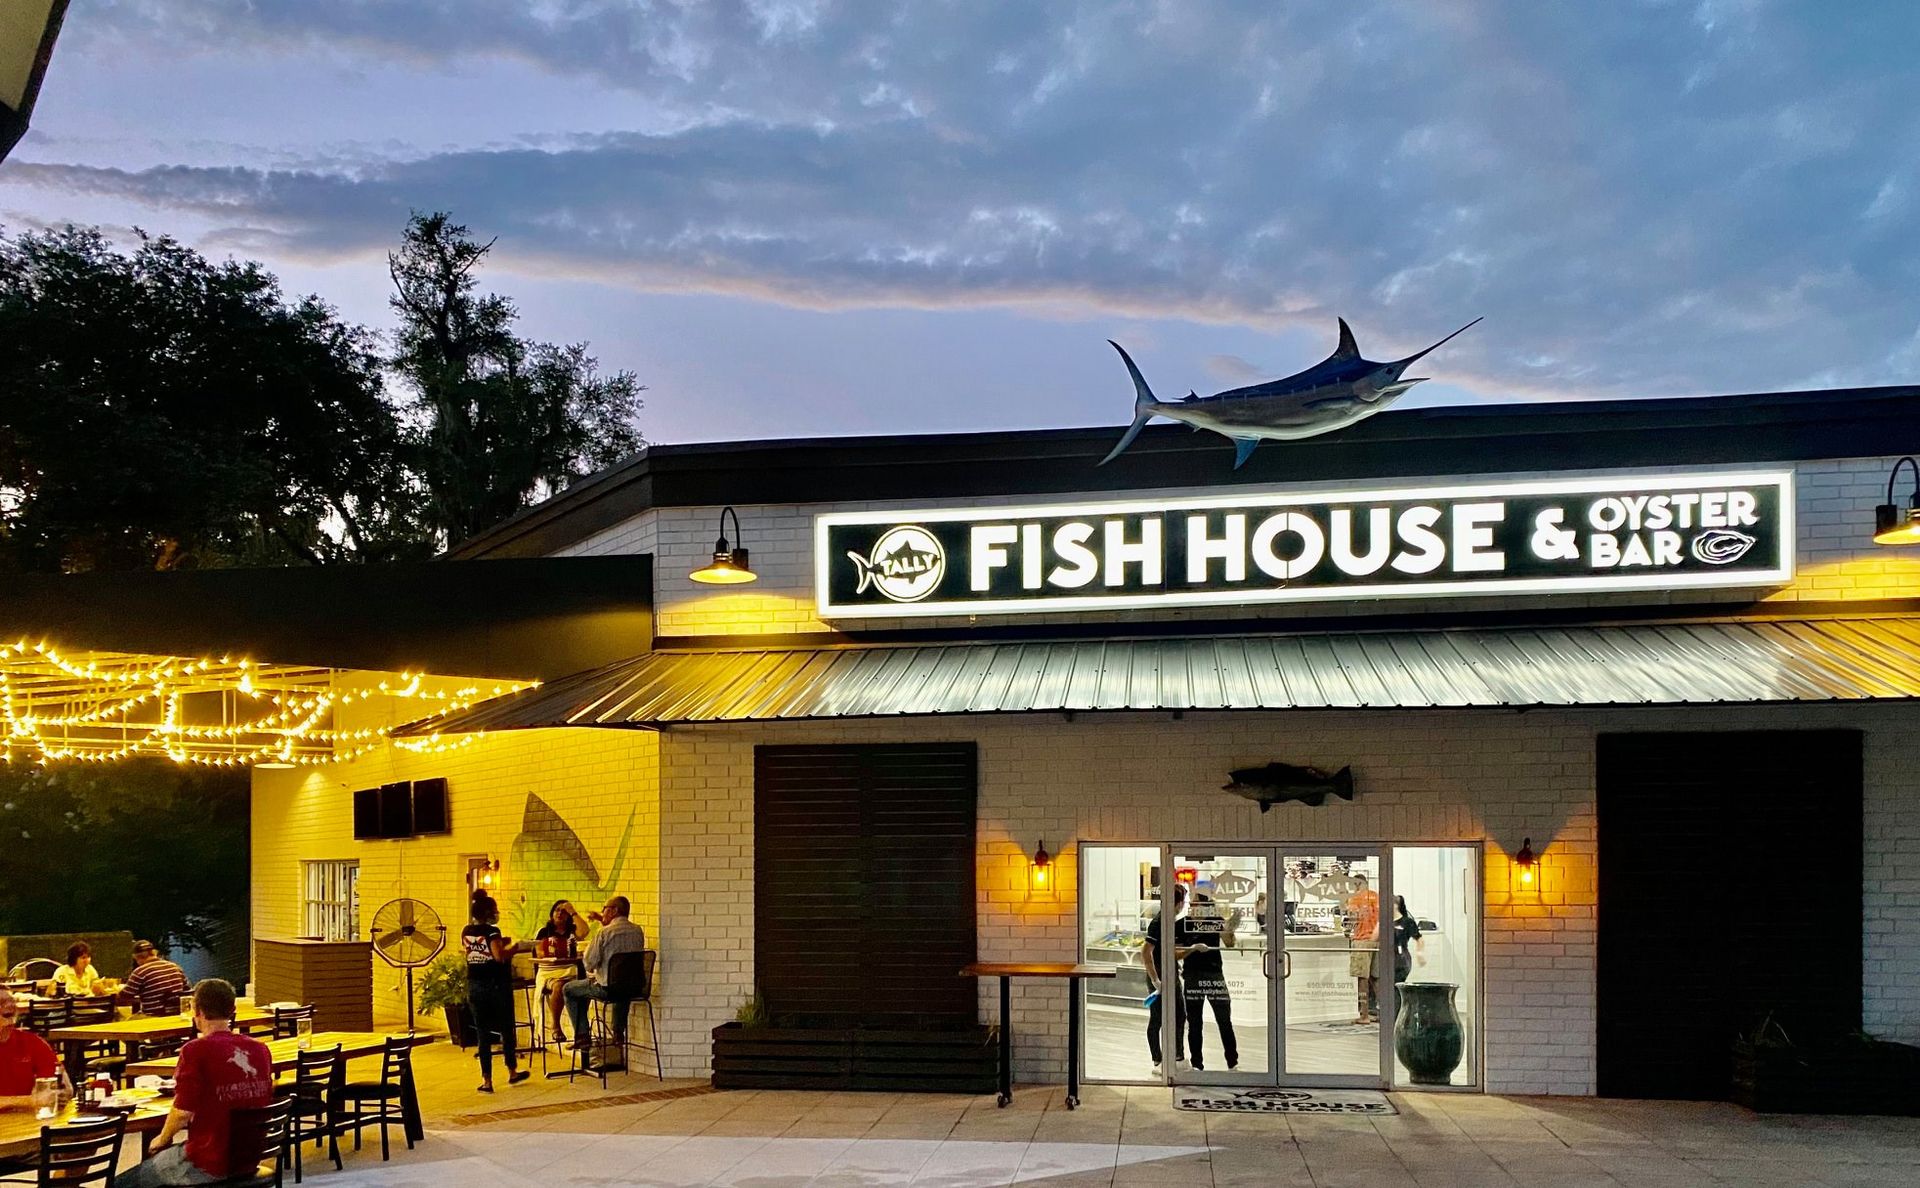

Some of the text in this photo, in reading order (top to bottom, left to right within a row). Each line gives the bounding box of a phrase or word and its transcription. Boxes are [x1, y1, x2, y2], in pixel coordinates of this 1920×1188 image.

[1588, 491, 1759, 531] OYSTER
[880, 502, 1580, 592] TALLY FISH HOUSE &
[1591, 531, 1684, 568] BAR
